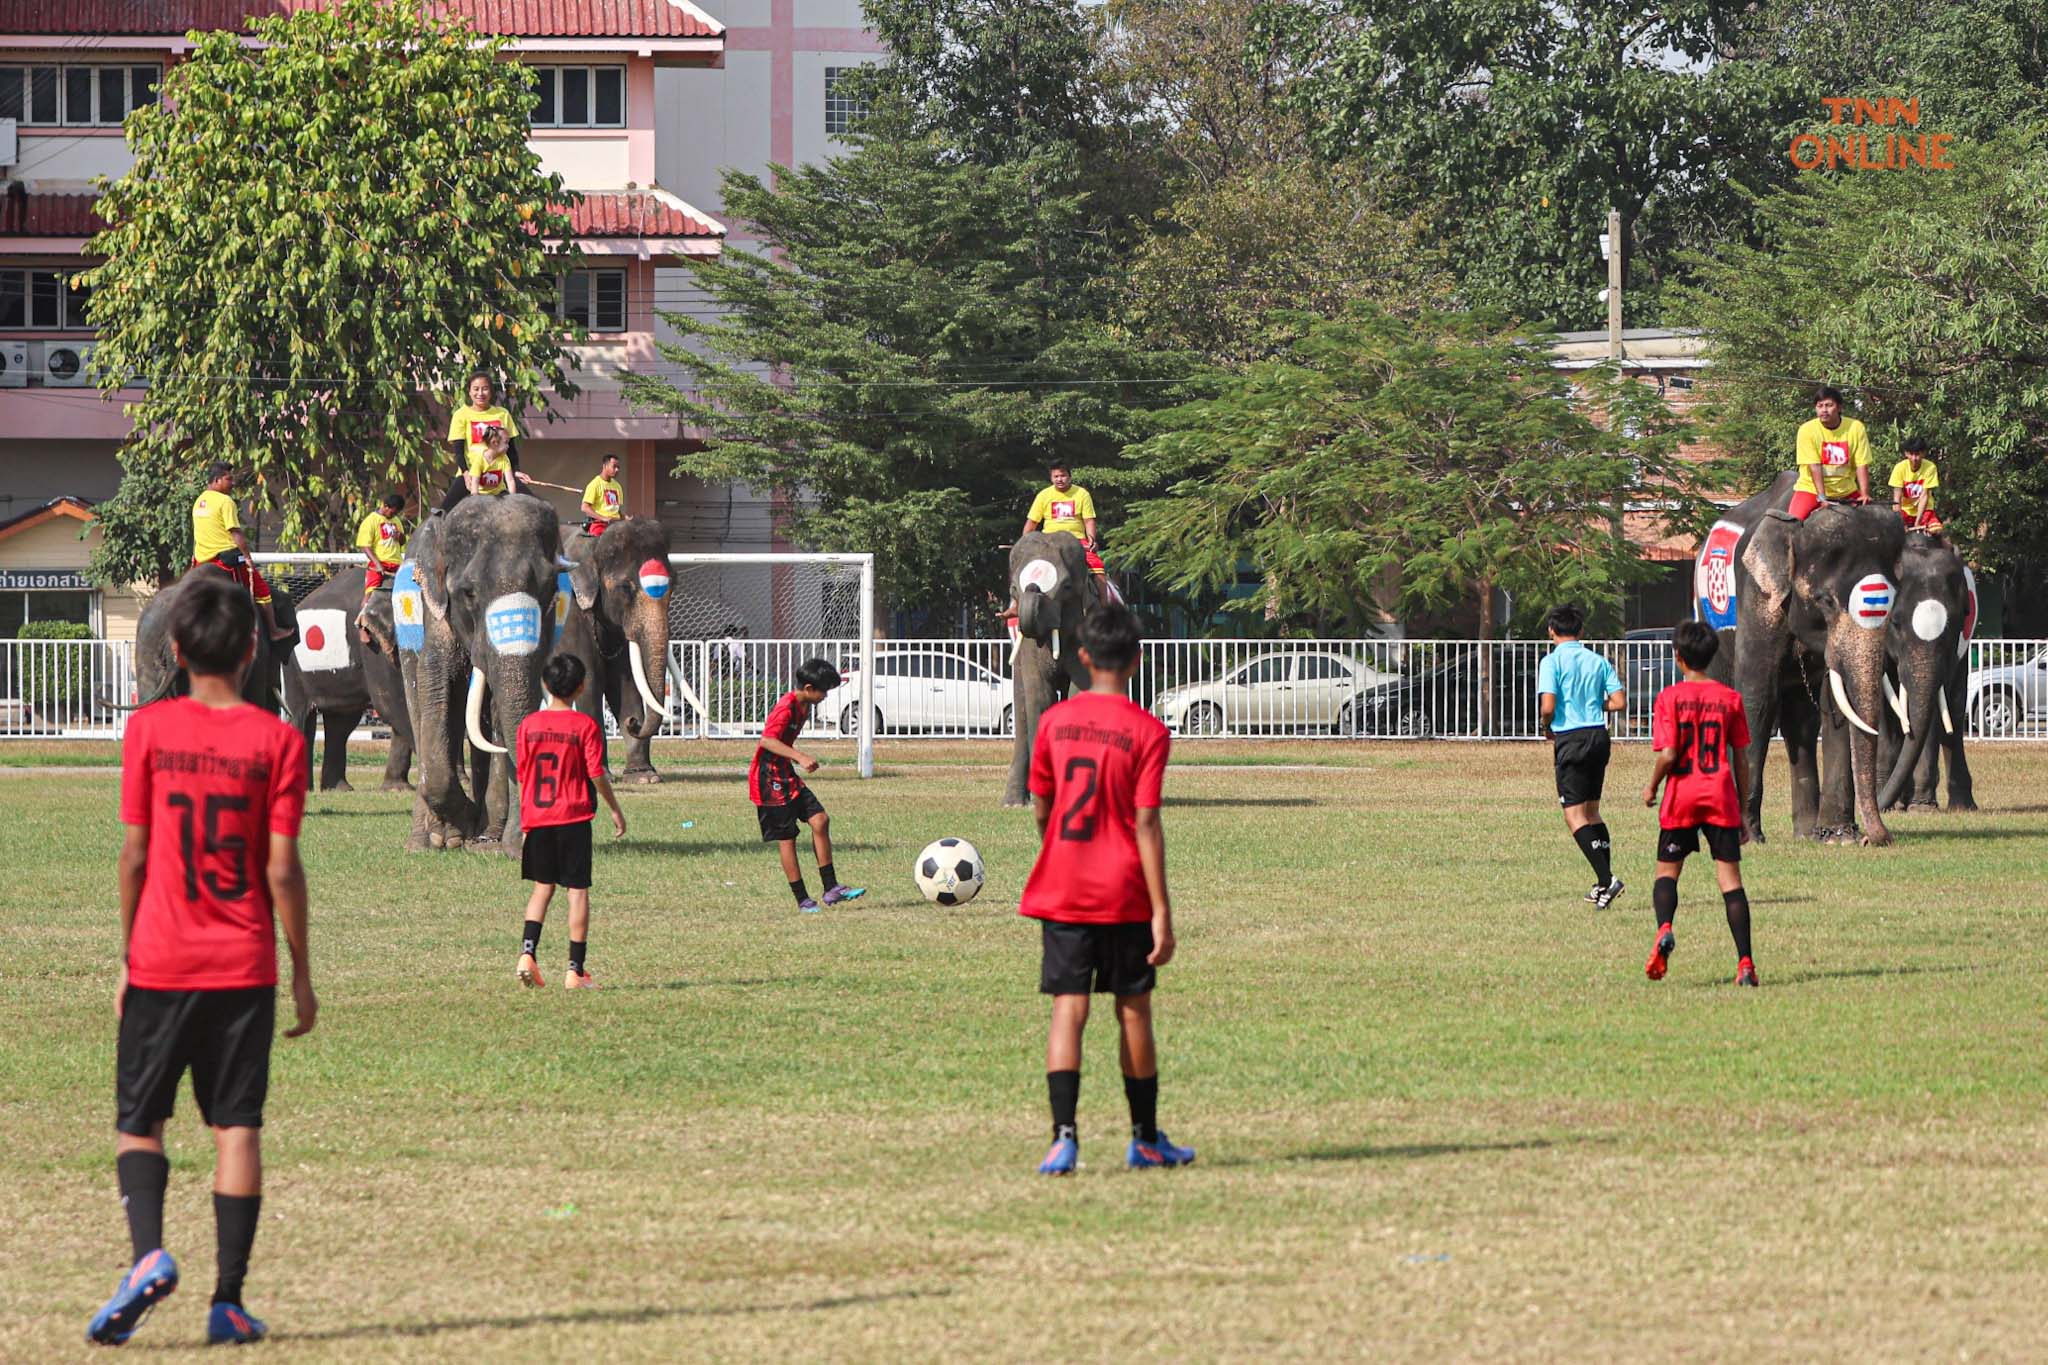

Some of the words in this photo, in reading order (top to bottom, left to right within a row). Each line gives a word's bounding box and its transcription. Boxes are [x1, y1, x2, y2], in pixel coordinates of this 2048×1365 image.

[533, 751, 559, 809] 6
[1671, 720, 1722, 775] 28
[1060, 755, 1098, 842] 2
[167, 792, 251, 902] 15
